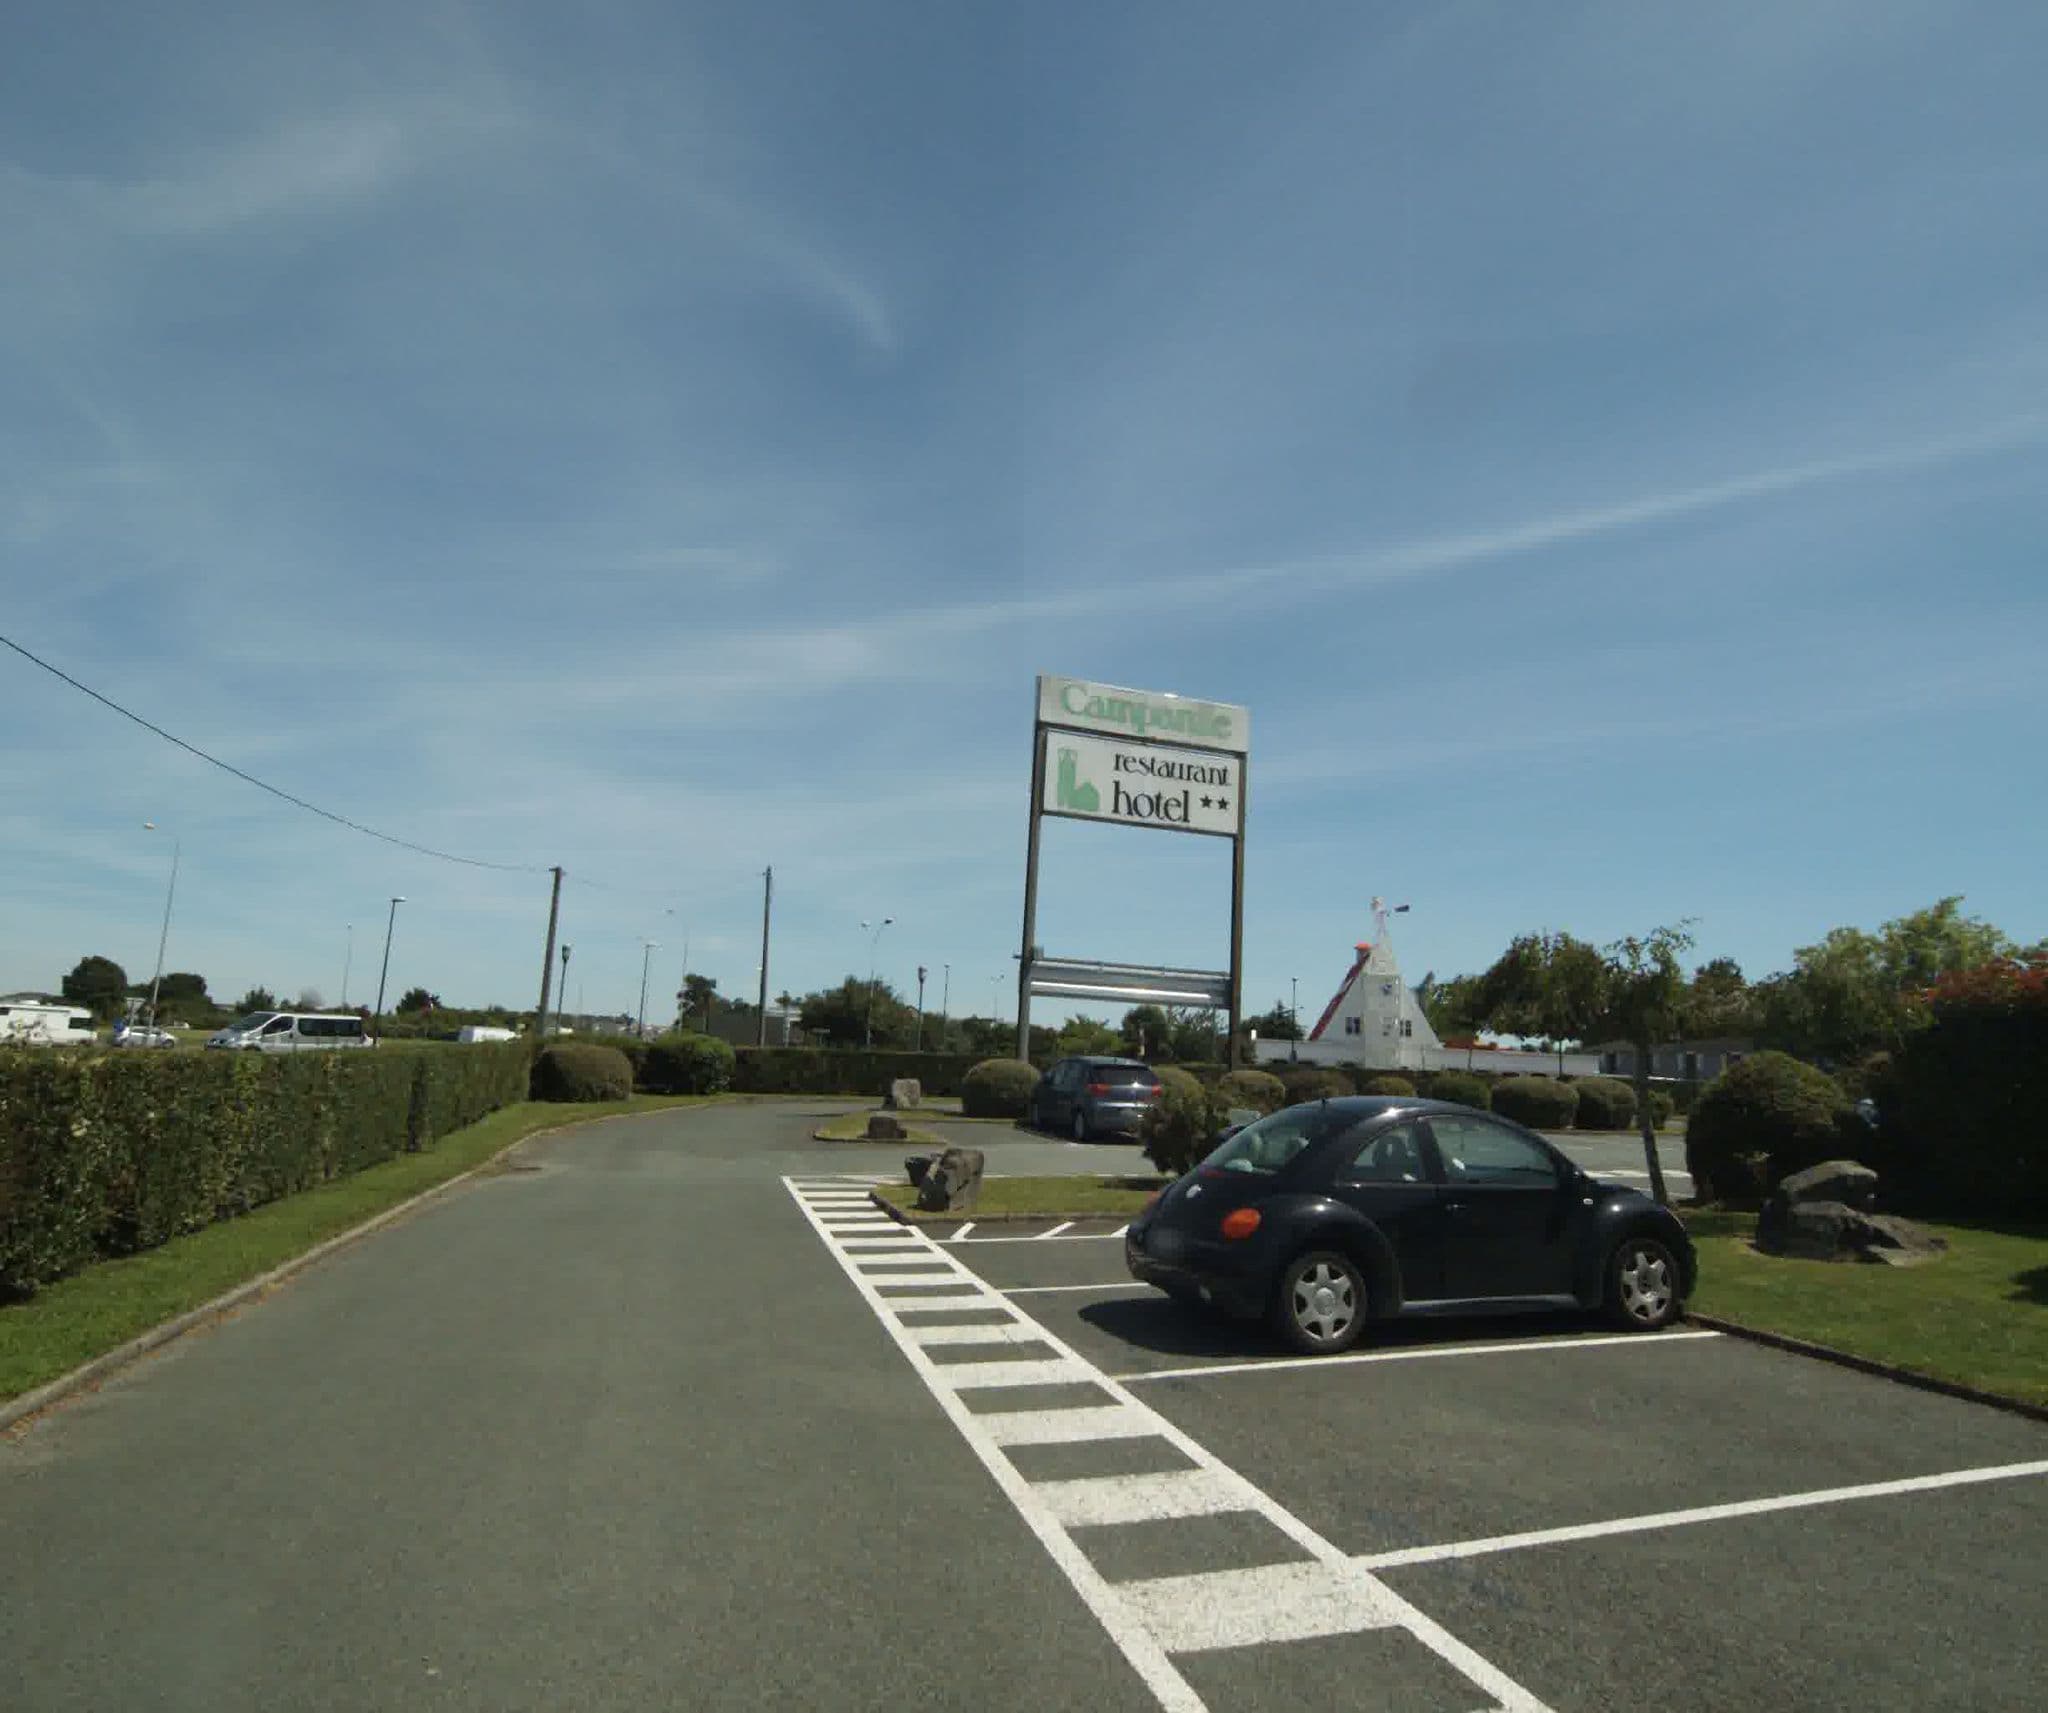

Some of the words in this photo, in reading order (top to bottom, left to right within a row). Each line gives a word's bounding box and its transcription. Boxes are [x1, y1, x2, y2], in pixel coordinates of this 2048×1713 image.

[1061, 684, 1232, 738] Campane
[1113, 753, 1231, 786] restaurant
[1111, 780, 1190, 823] hotel
